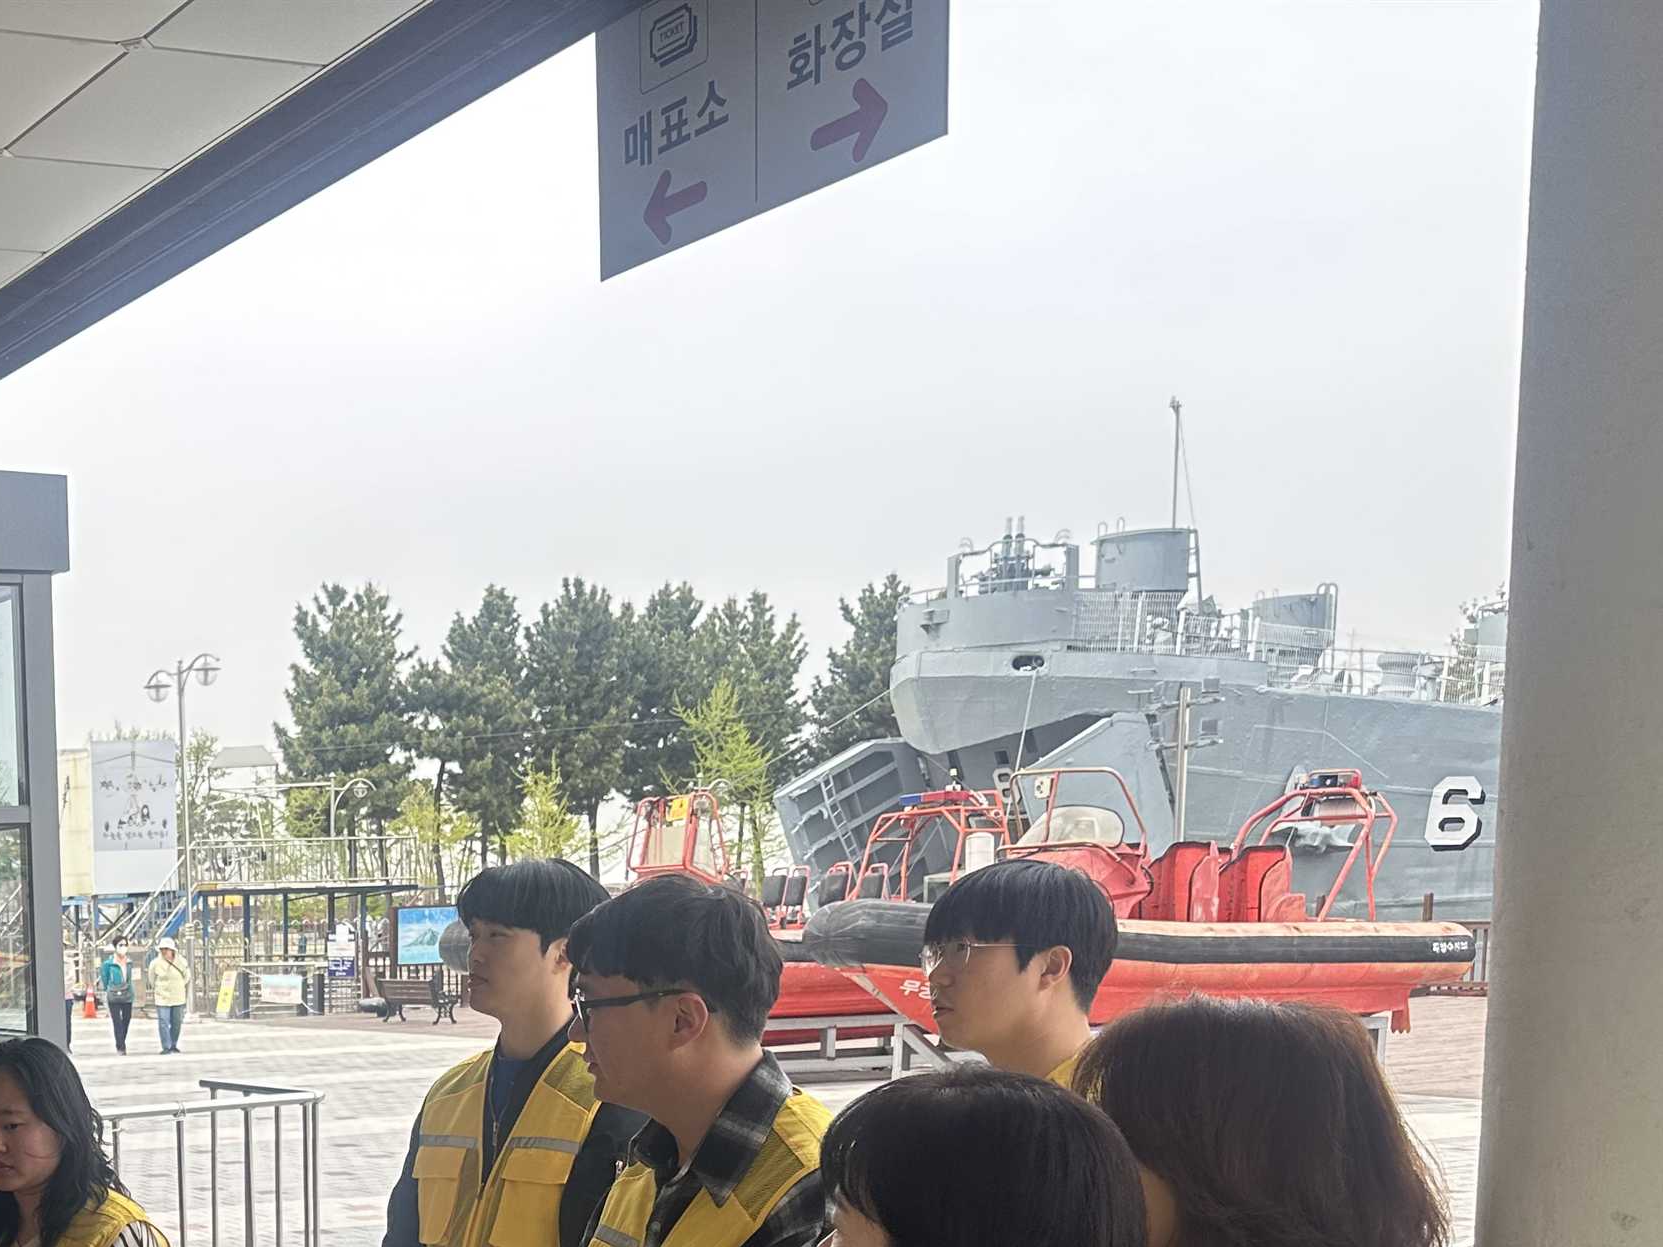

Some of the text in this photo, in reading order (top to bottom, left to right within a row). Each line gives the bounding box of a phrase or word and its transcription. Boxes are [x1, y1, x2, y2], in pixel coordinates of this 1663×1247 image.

[787, 0, 913, 90] 화장실
[624, 80, 729, 166] 매표소
[1424, 776, 1485, 851] 6
